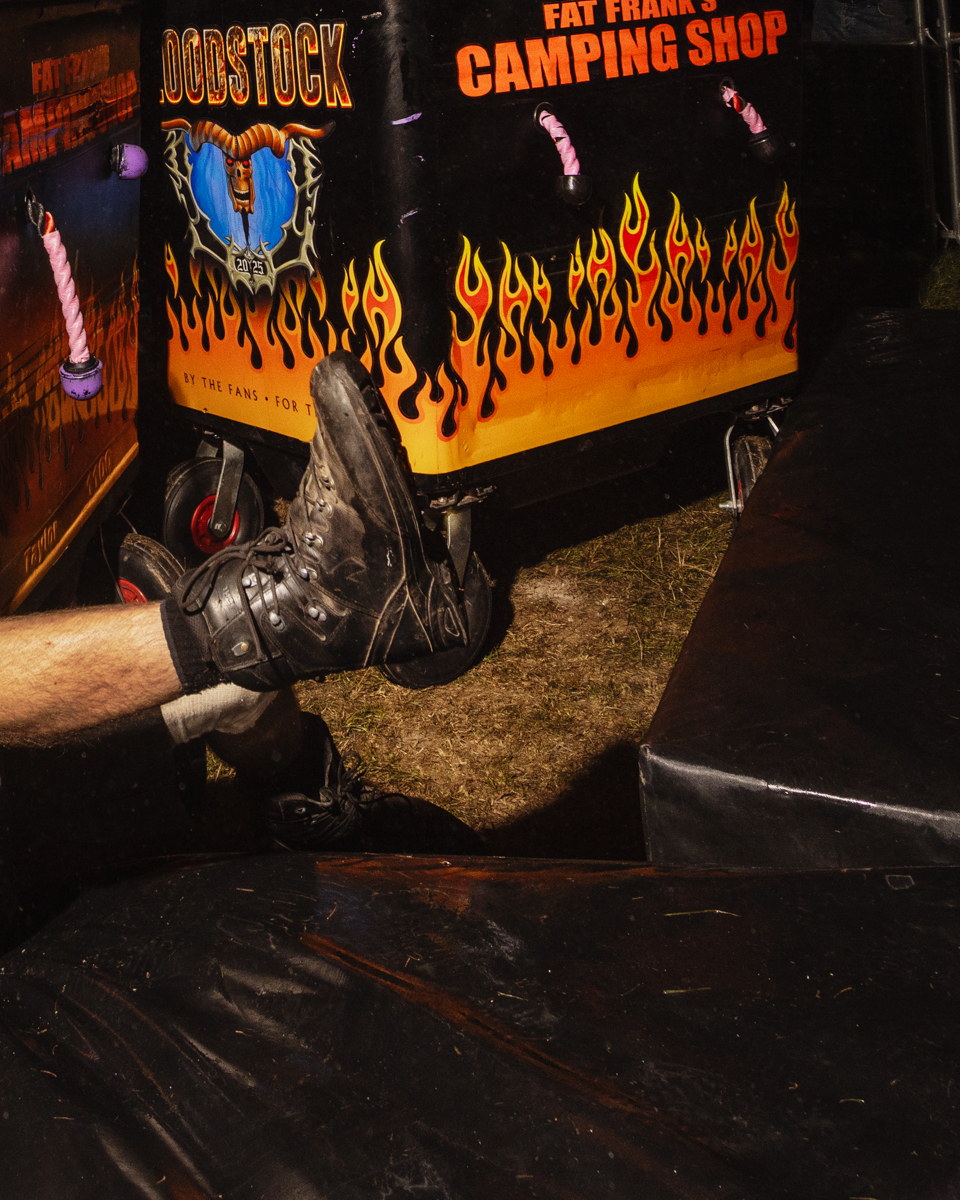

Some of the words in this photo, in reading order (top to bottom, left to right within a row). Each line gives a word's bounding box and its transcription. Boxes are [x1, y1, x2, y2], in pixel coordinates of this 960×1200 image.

[543, 0, 597, 30] FAT
[32, 59, 61, 95] FAT
[159, 22, 353, 109] OODSTOCK
[456, 22, 679, 98] CAMPING
[686, 10, 788, 67] SHOP
[183, 372, 195, 385] BY
[201, 377, 222, 392] THE
[228, 383, 258, 401] FANS
[275, 395, 299, 413] FOR
[23, 520, 58, 574] Taylor
